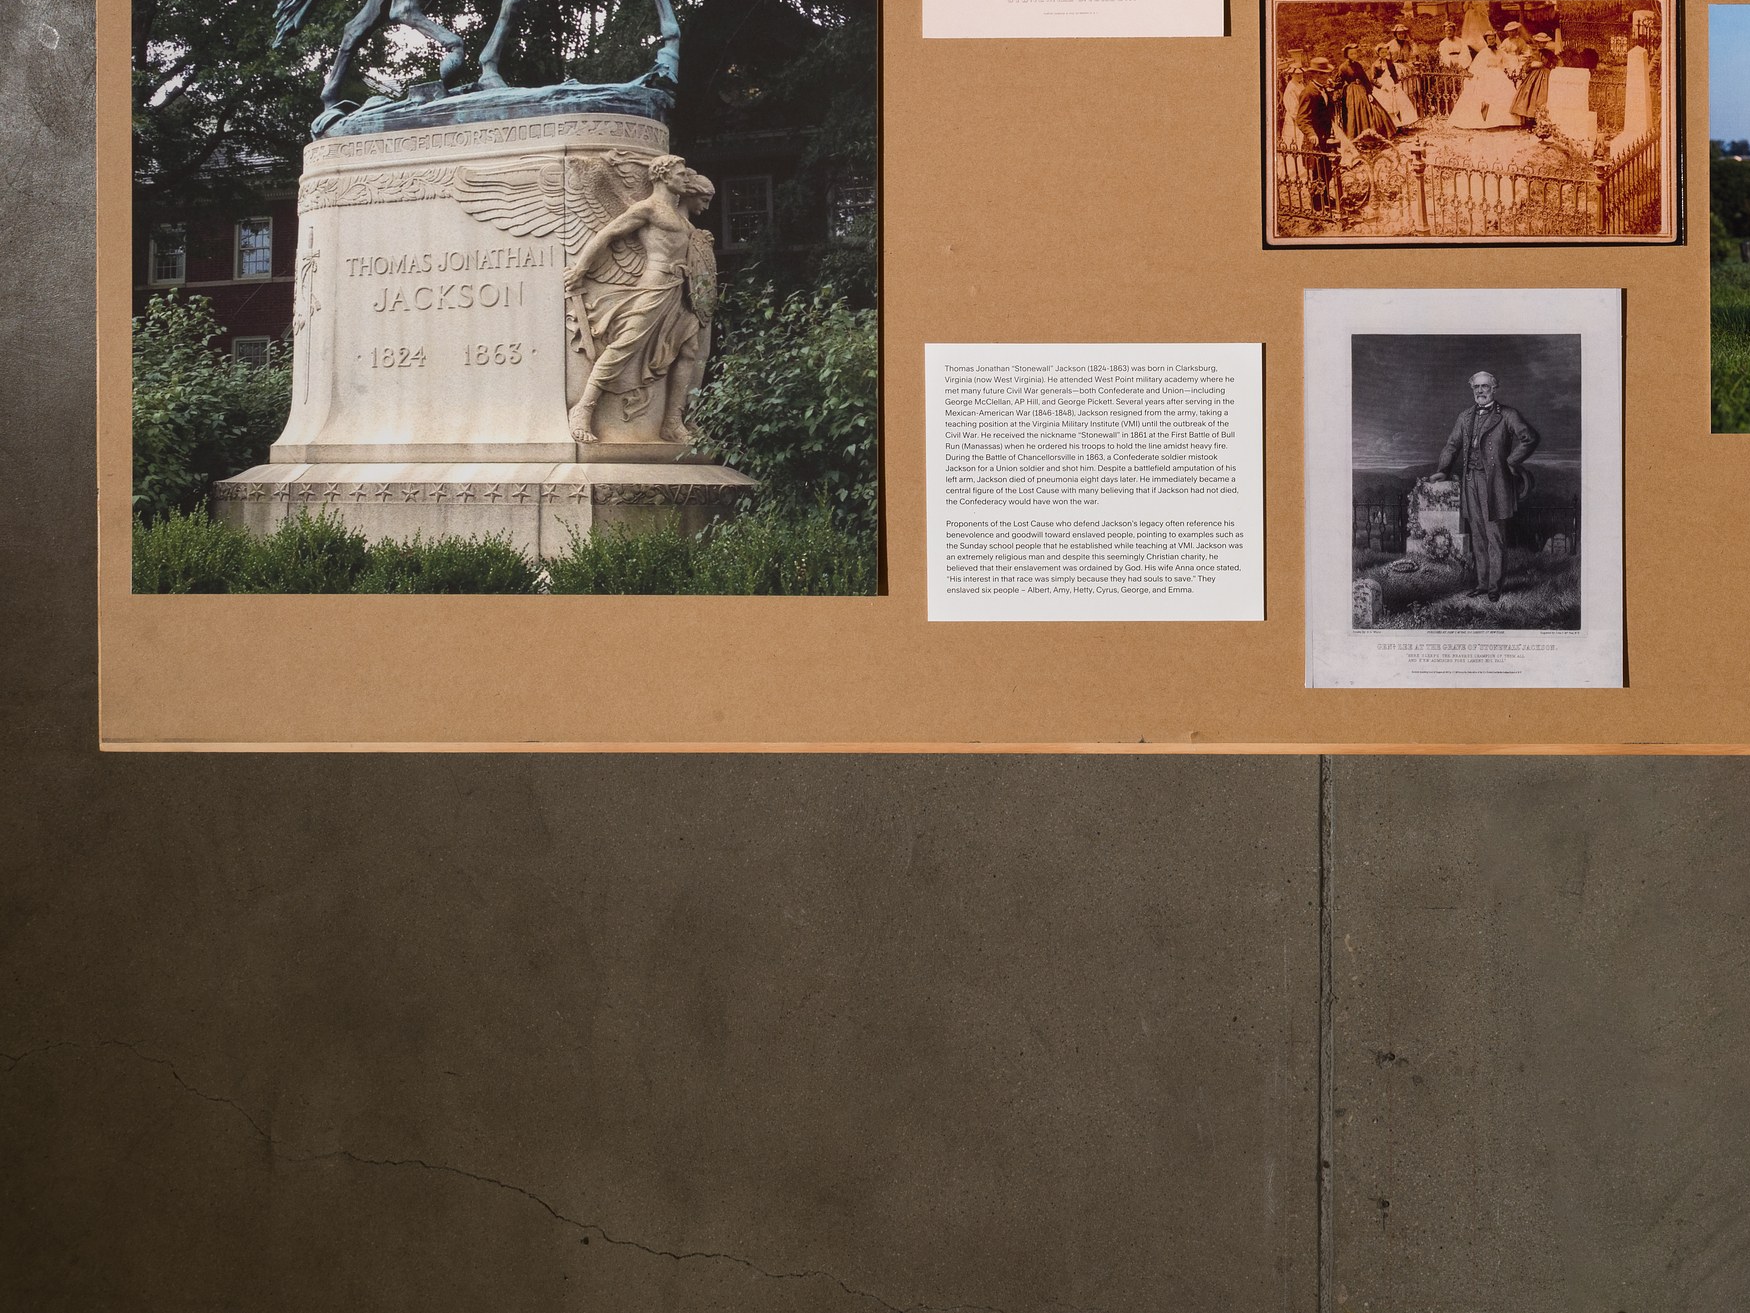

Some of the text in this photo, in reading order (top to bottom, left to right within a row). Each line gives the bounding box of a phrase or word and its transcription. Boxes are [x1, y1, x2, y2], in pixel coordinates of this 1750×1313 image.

[346, 245, 554, 277] THOMAS JONATHAN
[373, 281, 524, 312] JACKSON
[370, 342, 523, 369] 1824 1863
[944, 364, 974, 372] Thomas
[1175, 364, 1217, 373] Clarksburg,
